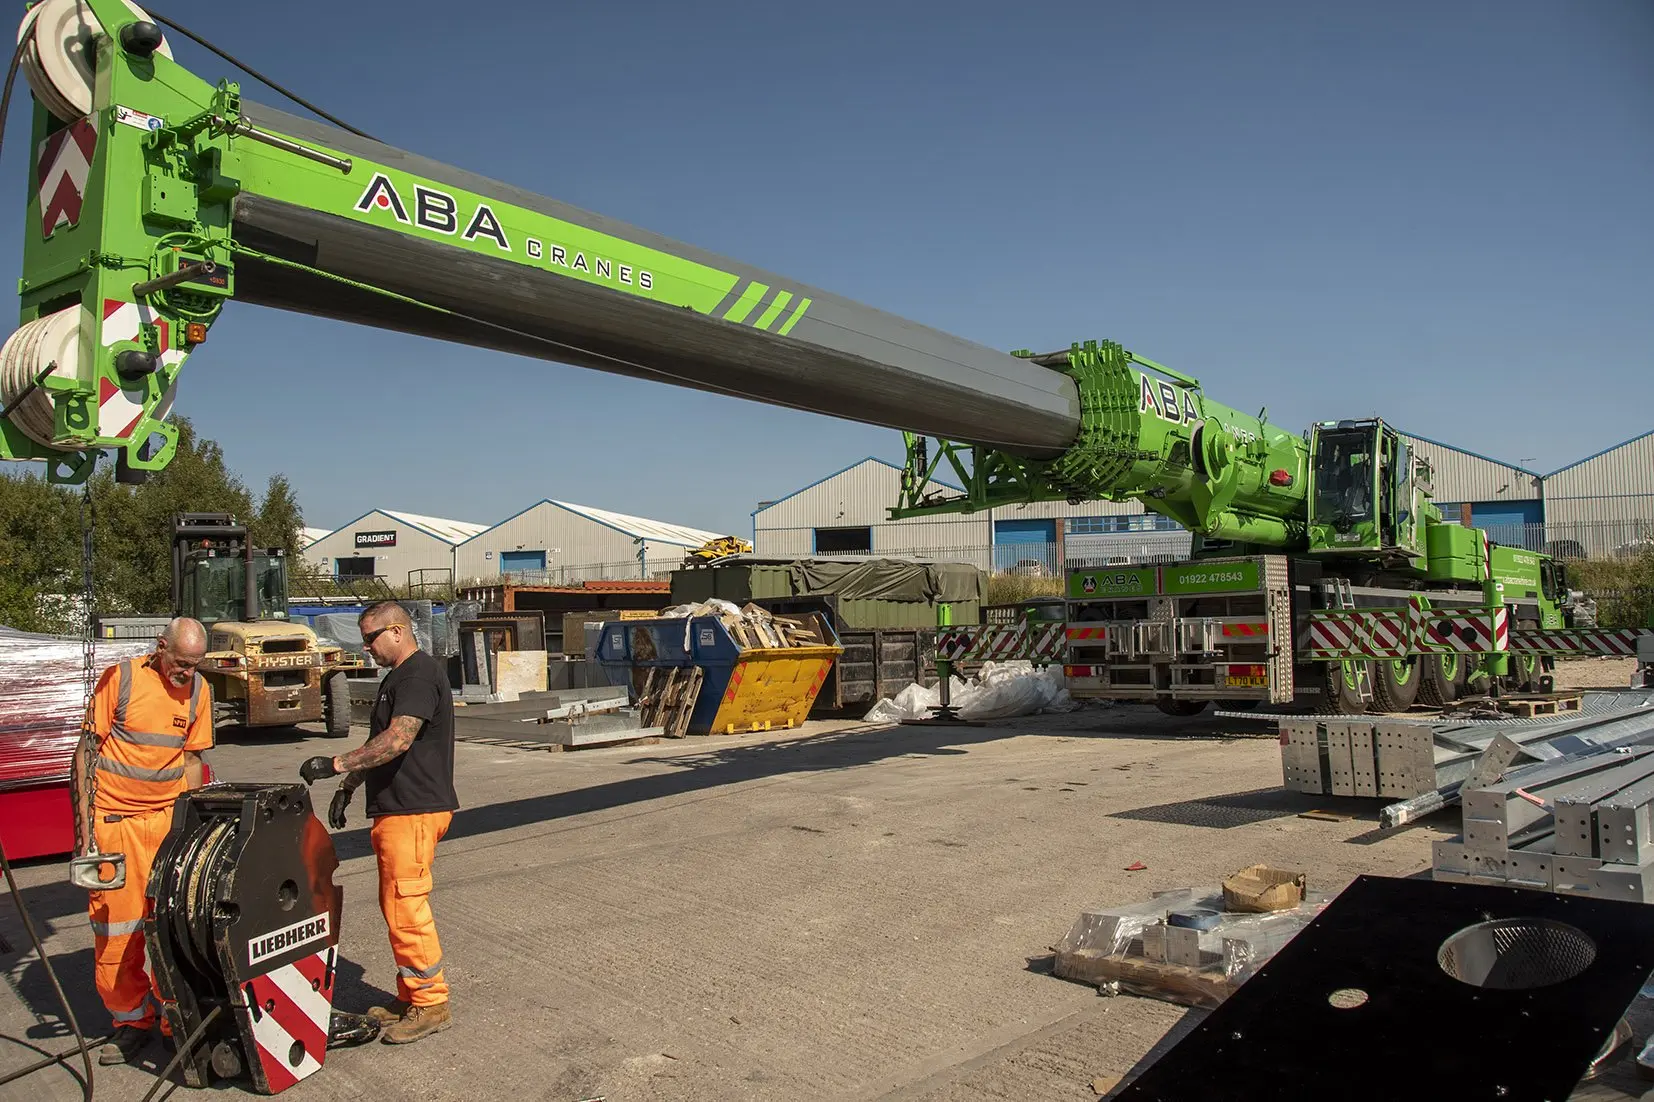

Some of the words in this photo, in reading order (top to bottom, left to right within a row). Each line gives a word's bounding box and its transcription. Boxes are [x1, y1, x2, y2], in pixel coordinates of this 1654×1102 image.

[354, 172, 512, 252] ABA
[526, 237, 653, 289] CRANES
[1140, 372, 1199, 427] ABA
[356, 534, 395, 544] GRADIENT
[1100, 574, 1141, 587] ABA
[1179, 573, 1207, 585] 01922
[1208, 571, 1243, 583] 478543
[258, 655, 312, 668] HYSTER
[252, 917, 326, 960] LIEBHERR
